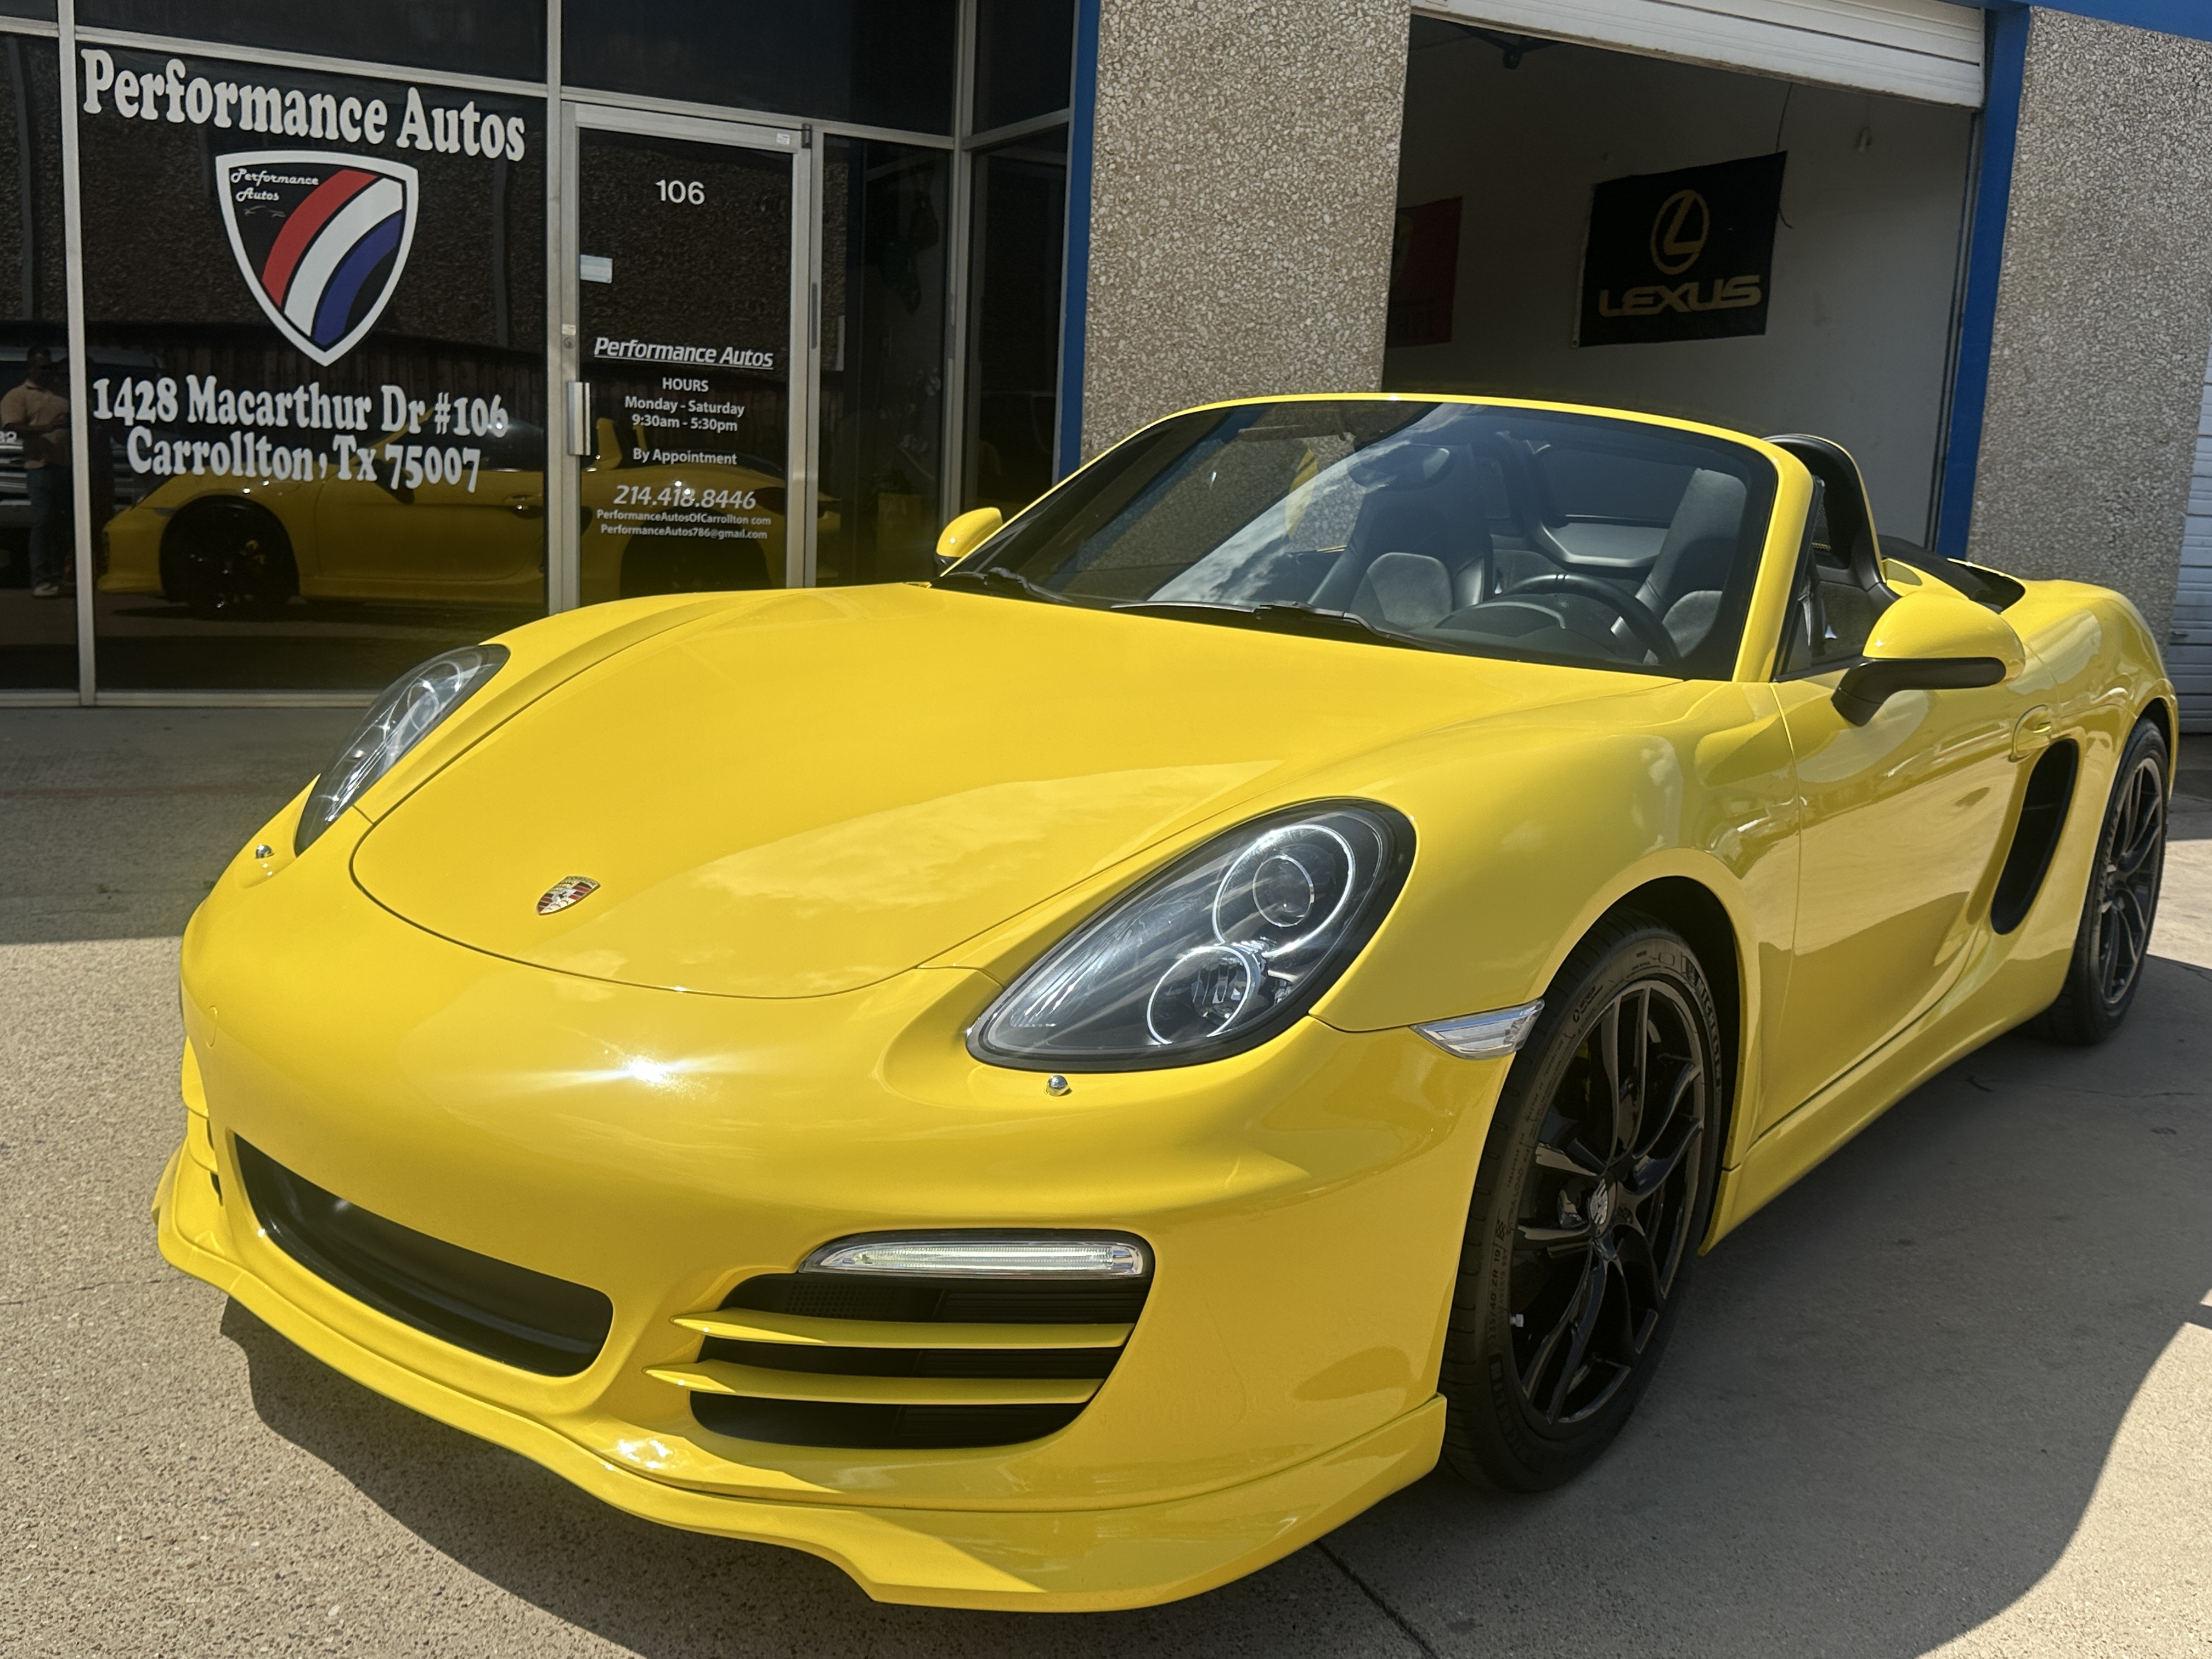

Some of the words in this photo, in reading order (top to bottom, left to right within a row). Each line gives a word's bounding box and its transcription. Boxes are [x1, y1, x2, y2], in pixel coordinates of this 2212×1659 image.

[81, 49, 388, 144] Performance
[396, 87, 525, 161] Autos
[230, 168, 319, 187] Performance
[235, 187, 279, 202] Autos
[656, 179, 705, 205] 106
[1599, 275, 1762, 317] LEXUS
[594, 336, 716, 363] Performance
[719, 346, 774, 367] Autos
[662, 377, 709, 392] HOURS
[93, 377, 178, 427] 1428
[186, 375, 373, 431] Macarthur
[380, 385, 426, 434] Dr
[434, 392, 508, 438] #106
[625, 396, 678, 413] Monday
[688, 400, 745, 417] Saturday
[632, 414, 680, 428] 9:30am
[690, 417, 737, 433] 5:30pm
[127, 426, 328, 482] Carrollton,
[332, 434, 378, 481] Tx
[385, 443, 481, 493] 75007
[633, 448, 651, 463] By
[652, 449, 737, 465] Appointment
[613, 485, 757, 509] 214.418.8446
[600, 524, 768, 539] PerformanceAutos786@gmail.com
[1493, 1249, 1500, 1262] 19
[1491, 1269, 1498, 1287] ZR
[1489, 1293, 1498, 1341] 235/40
